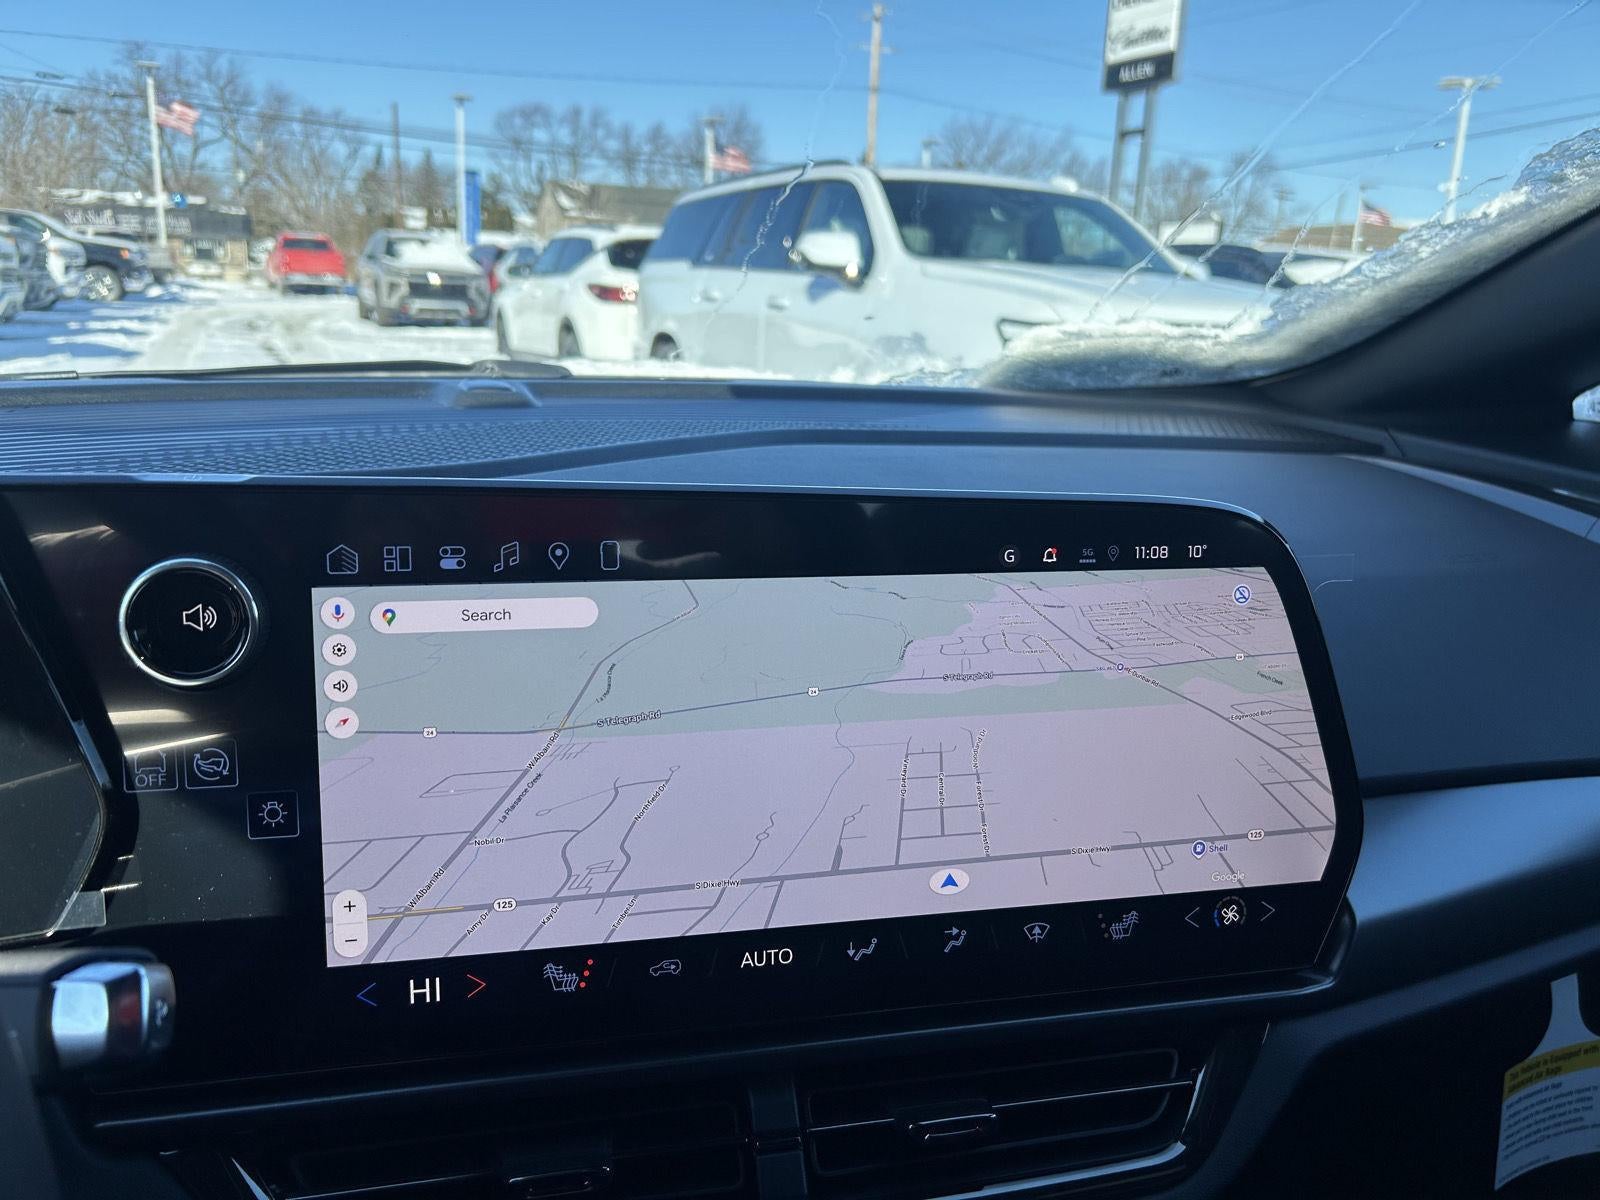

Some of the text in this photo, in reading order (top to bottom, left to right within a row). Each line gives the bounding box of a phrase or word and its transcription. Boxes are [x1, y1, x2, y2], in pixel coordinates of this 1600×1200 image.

[1004, 550, 1015, 563] G
[1082, 549, 1094, 557] 5G
[1135, 545, 1169, 559] 11:08
[1187, 544, 1208, 559] 10°
[461, 608, 512, 622] Search
[597, 710, 661, 727] S Telegraph Rd
[1231, 711, 1260, 721] Edgewood
[526, 732, 559, 770] W Albain Rd
[135, 773, 167, 788] OFF
[634, 783, 667, 821] Northfield Dr
[978, 803, 985, 811] Dr
[499, 813, 507, 823] La
[1249, 831, 1262, 839] 125
[1077, 846, 1095, 854] Dixie
[1096, 845, 1111, 854] Hwy
[1209, 844, 1228, 853] Shell
[1211, 871, 1245, 883] Google
[408, 868, 445, 909] W Albain Rd
[703, 880, 722, 889] Dixie
[723, 879, 740, 888] Hwy
[496, 901, 513, 910] 125
[480, 911, 490, 922] Dr
[541, 904, 561, 926] Kay Dr
[611, 897, 637, 930] Timber Ln
[741, 948, 794, 968] AUTO
[408, 977, 441, 1003] HI
